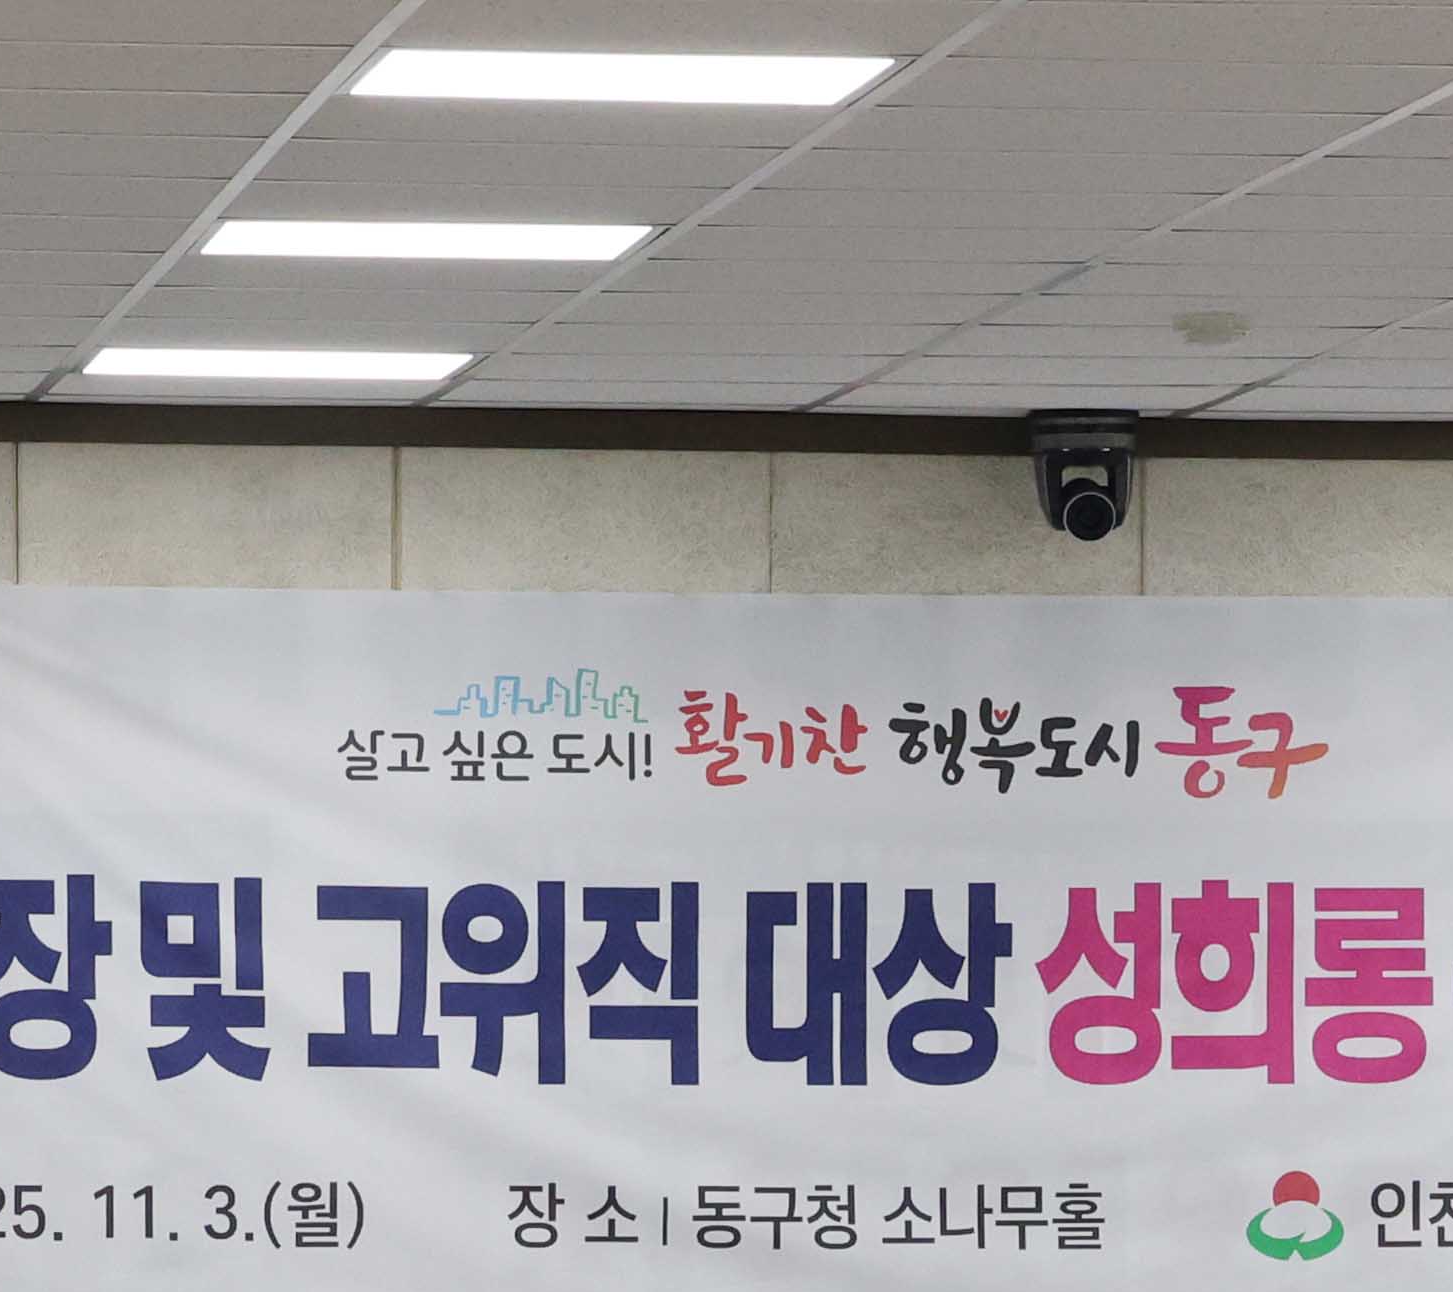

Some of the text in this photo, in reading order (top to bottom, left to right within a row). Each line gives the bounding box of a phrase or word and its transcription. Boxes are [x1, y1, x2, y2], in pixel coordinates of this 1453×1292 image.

[337, 685, 1329, 800] 살고 싶은 도시! 활기찬 행복도시 동구
[139, 877, 271, 1081] 및
[307, 880, 700, 1086] 고위직
[745, 882, 1013, 1086] 대상
[92, 1183, 179, 1241] 11.
[203, 1180, 364, 1249] 3.(월)
[692, 1183, 858, 1250] 동구청
[881, 1183, 1106, 1251] 소나무홀
